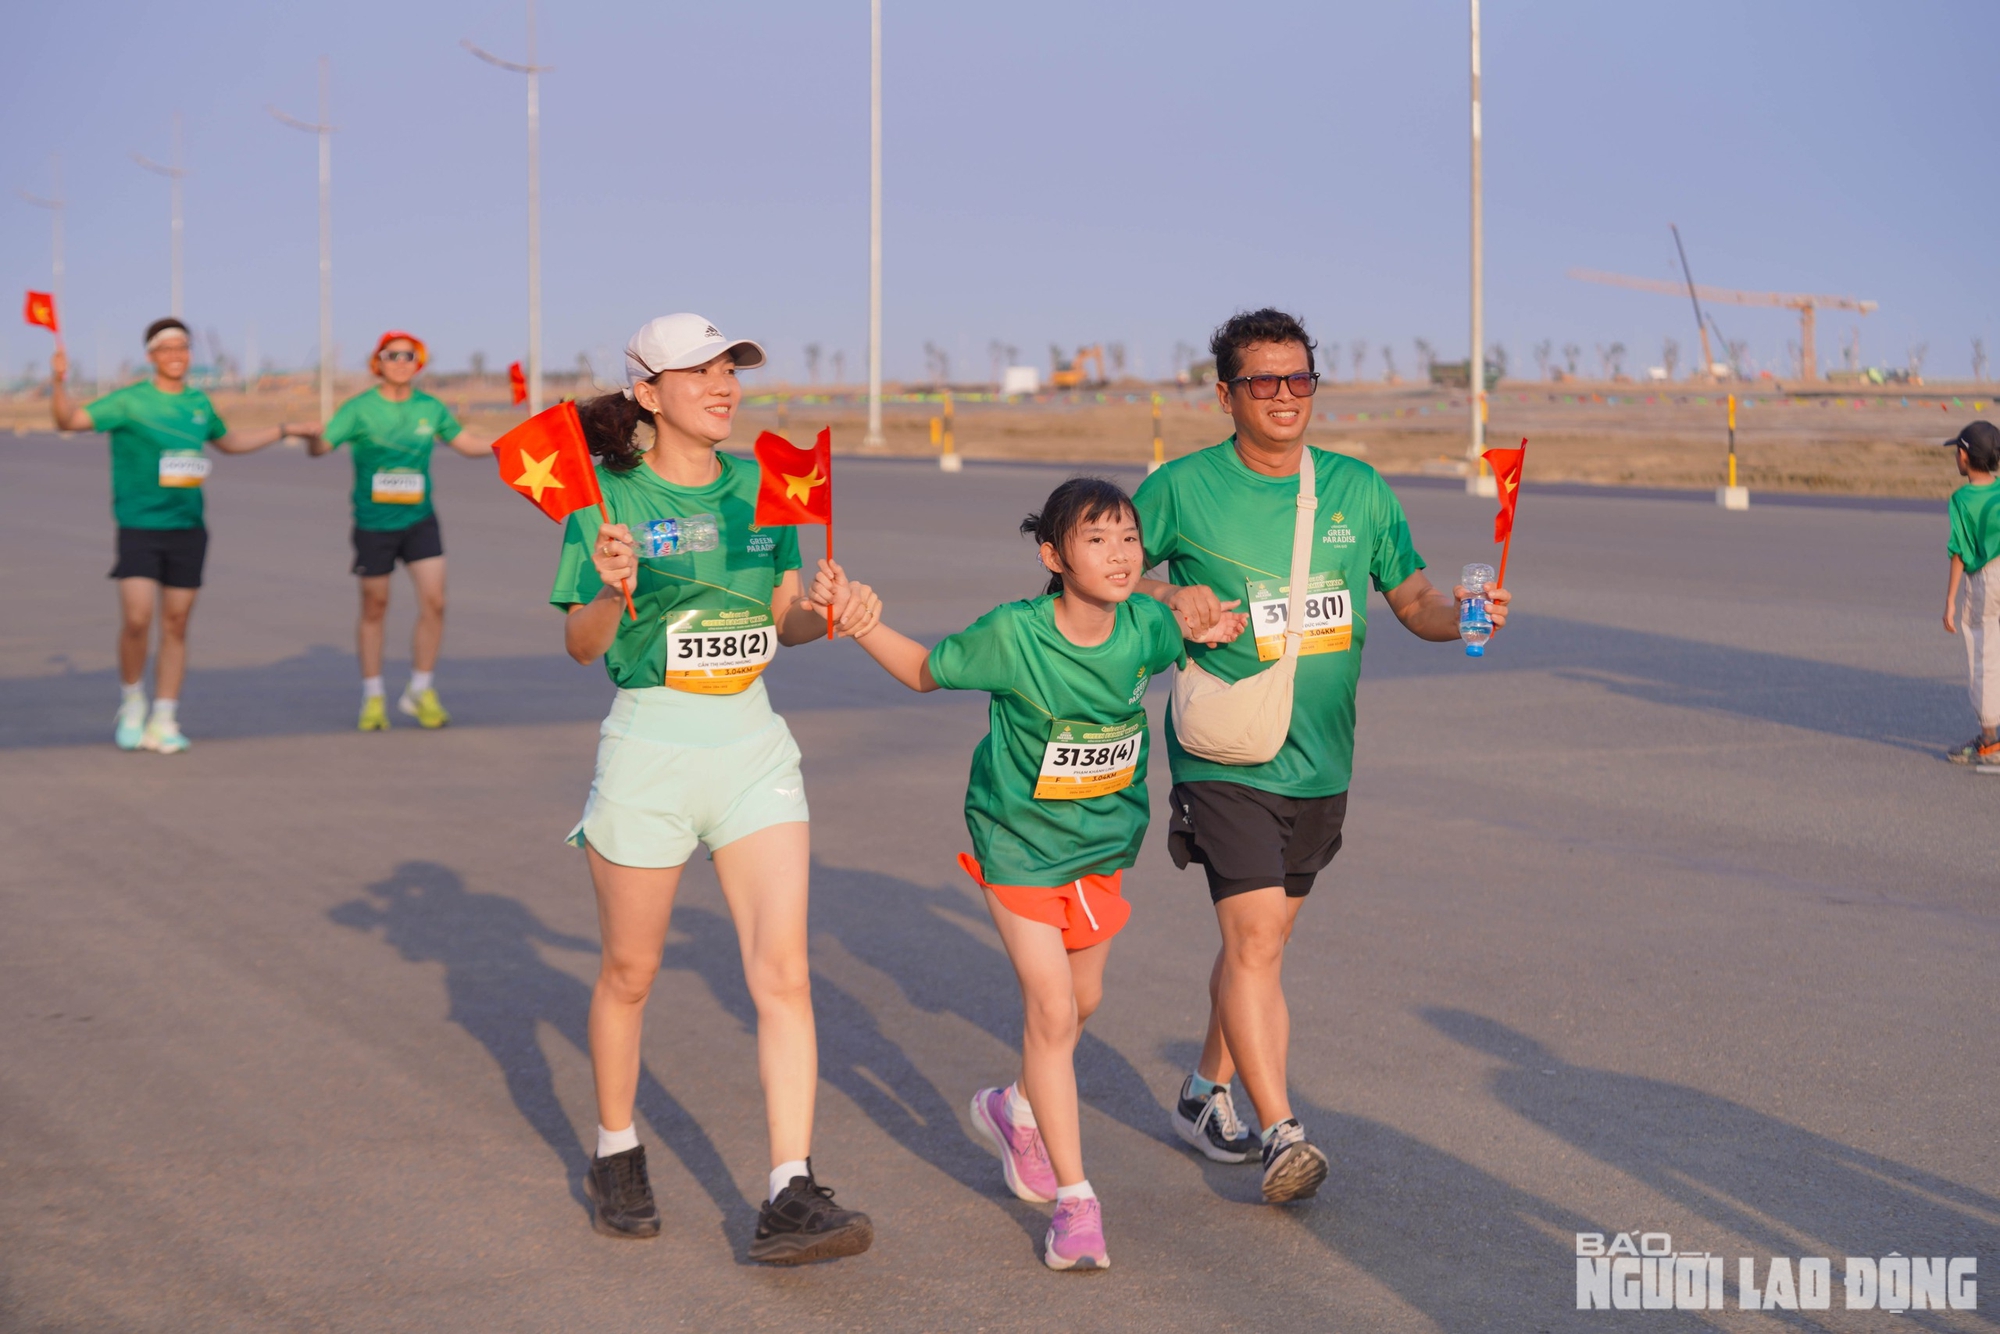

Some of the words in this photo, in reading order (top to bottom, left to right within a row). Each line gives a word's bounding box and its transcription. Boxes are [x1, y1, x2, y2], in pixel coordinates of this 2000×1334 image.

[749, 537, 773, 545] GREEN
[1263, 595, 1344, 624] 318(1)
[1310, 628, 1336, 636] 3.04KM
[678, 632, 768, 659] 3138(2)
[725, 667, 753, 675] 3.04KM
[1053, 739, 1135, 766] 3138(4)
[1092, 772, 1117, 782] 3.04KM
